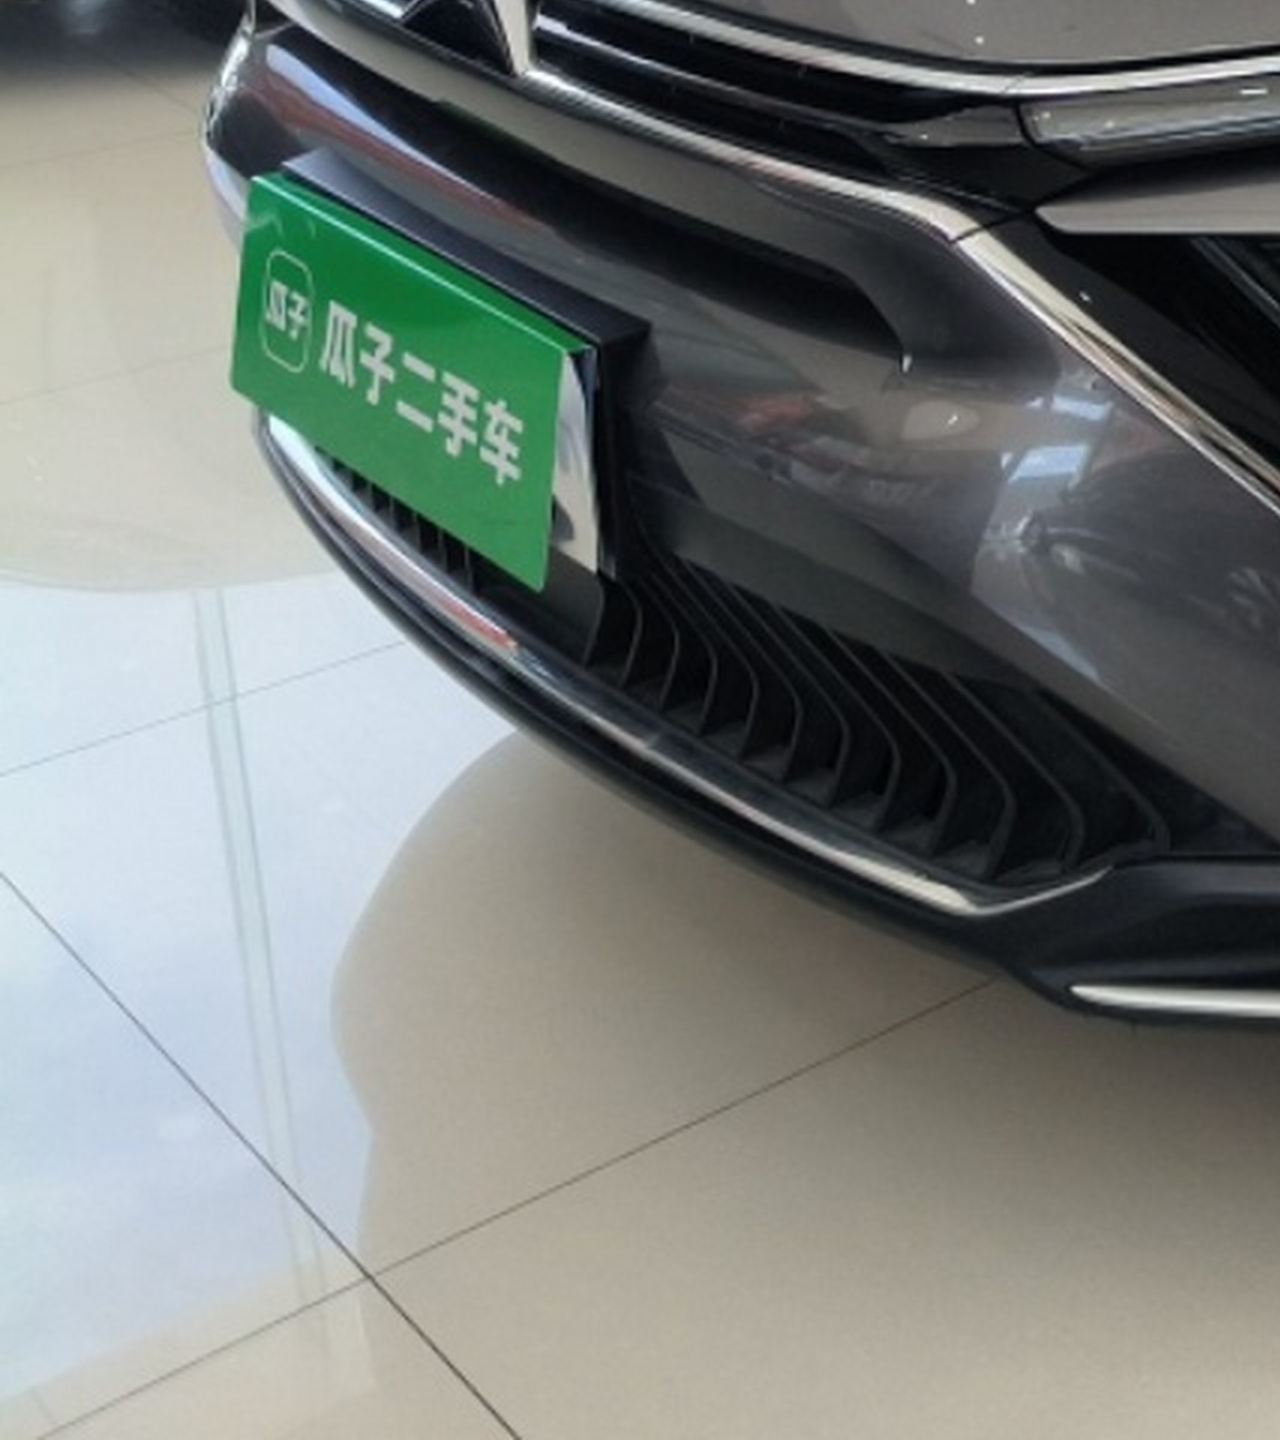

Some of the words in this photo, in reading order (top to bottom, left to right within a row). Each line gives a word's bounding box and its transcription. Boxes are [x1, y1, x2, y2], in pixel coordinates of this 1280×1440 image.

[265, 279, 309, 341] 瓜子
[318, 299, 524, 485] 瓜子二手车
